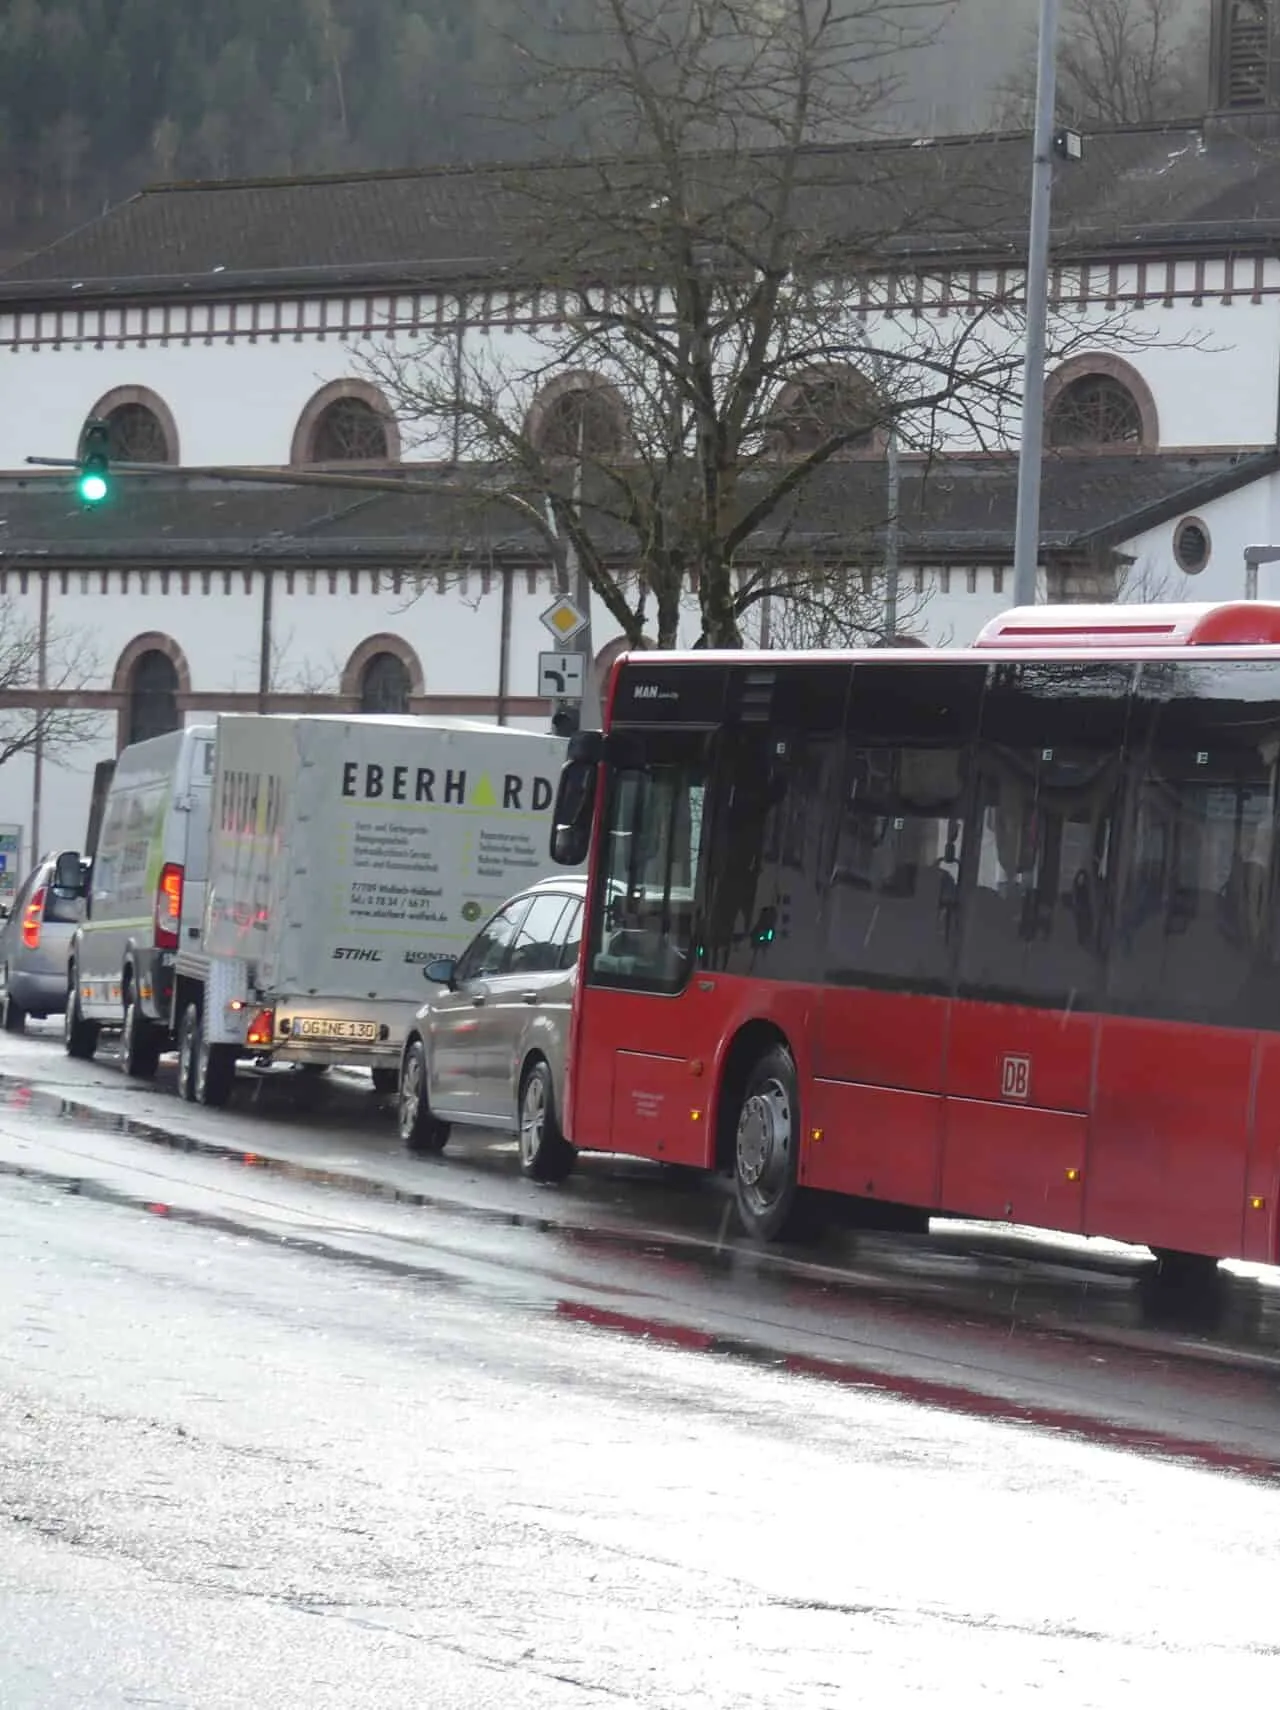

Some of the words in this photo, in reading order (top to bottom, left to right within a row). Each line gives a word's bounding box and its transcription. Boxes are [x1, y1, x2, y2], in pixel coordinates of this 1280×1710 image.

[634, 685, 659, 699] MAN
[333, 947, 382, 961] STIHL
[1004, 1059, 1027, 1094] DB
